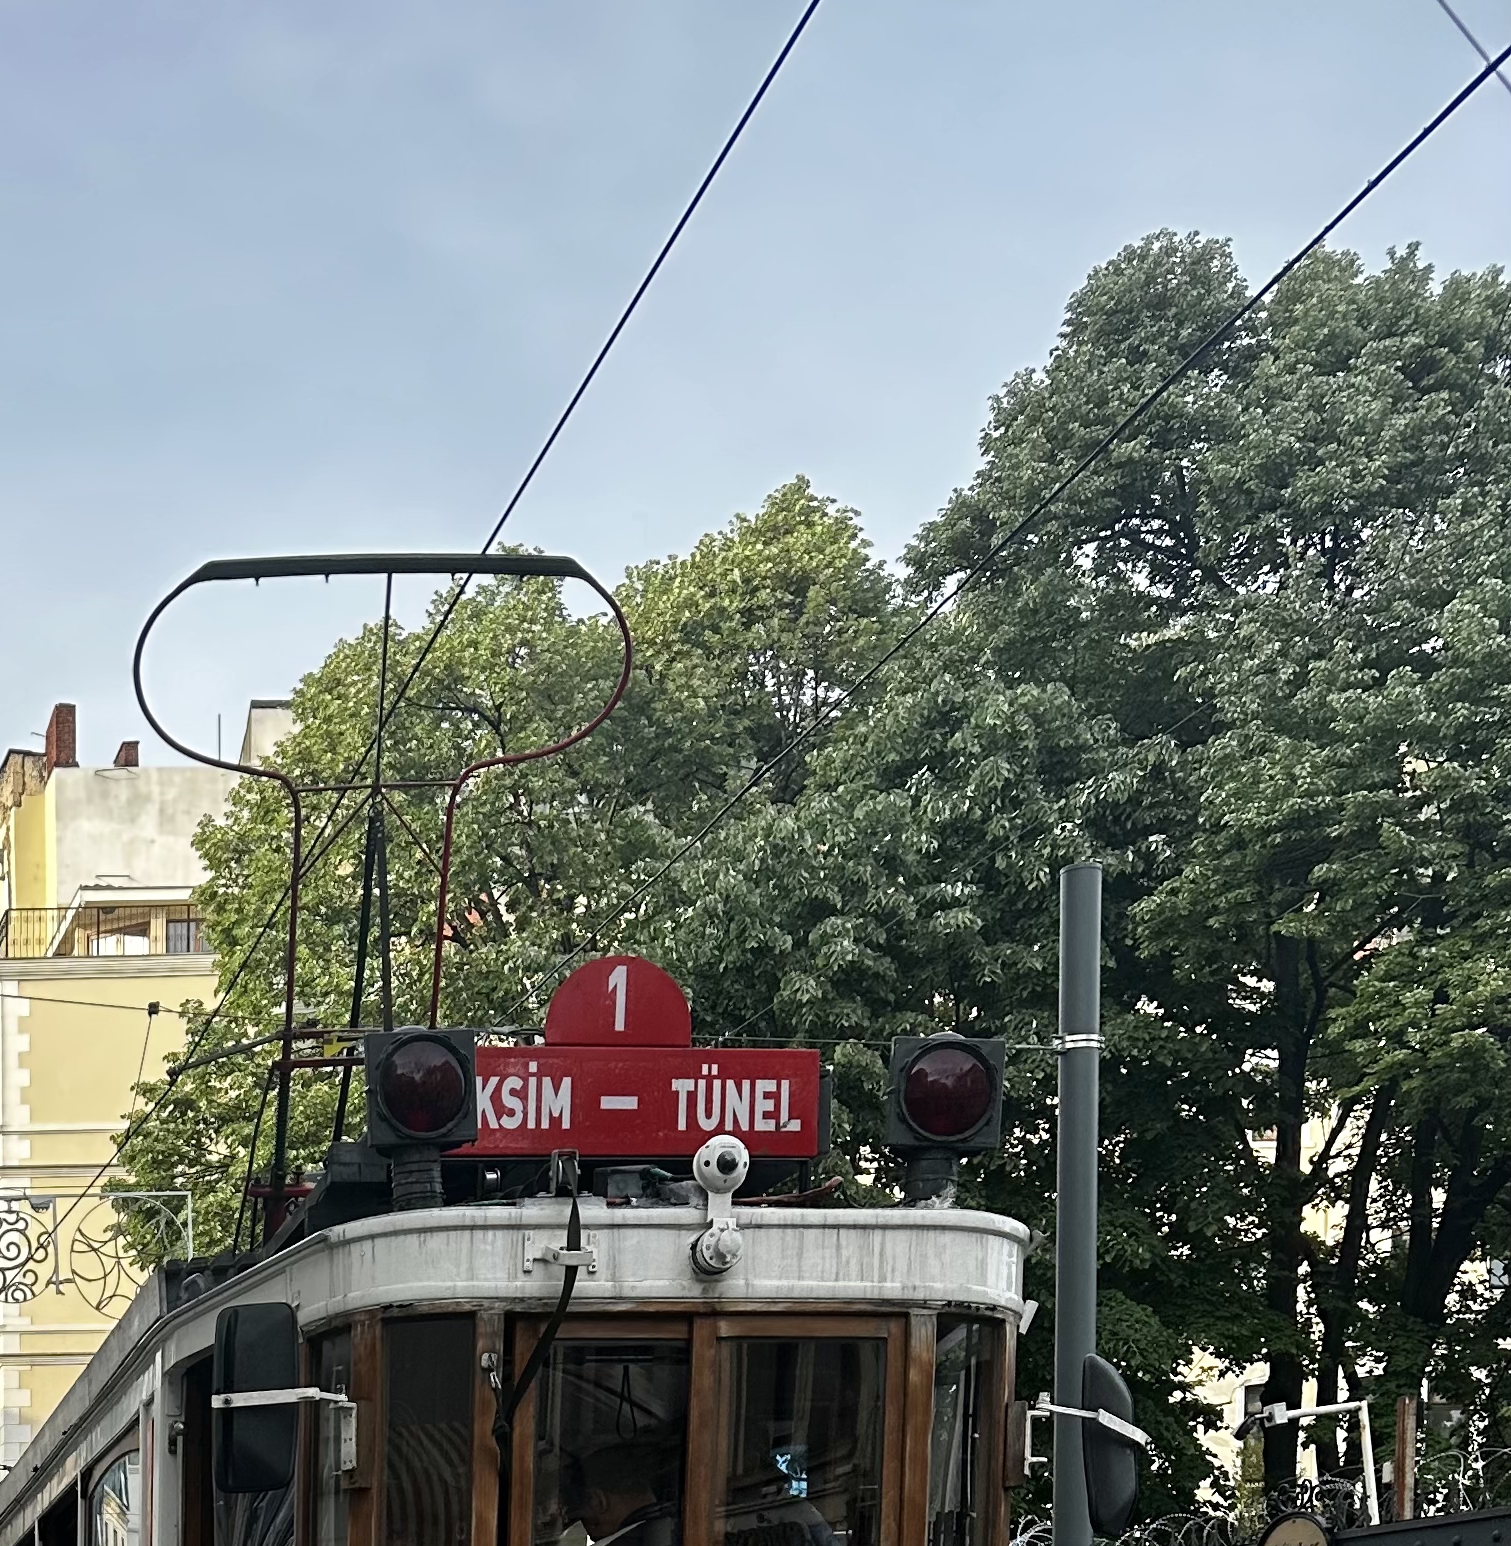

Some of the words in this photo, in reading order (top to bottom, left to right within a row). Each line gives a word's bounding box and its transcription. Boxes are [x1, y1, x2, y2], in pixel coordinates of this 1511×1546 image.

[607, 964, 628, 1032] 1
[475, 1061, 572, 1130] KSİM
[671, 1063, 802, 1132] TÜNEL
